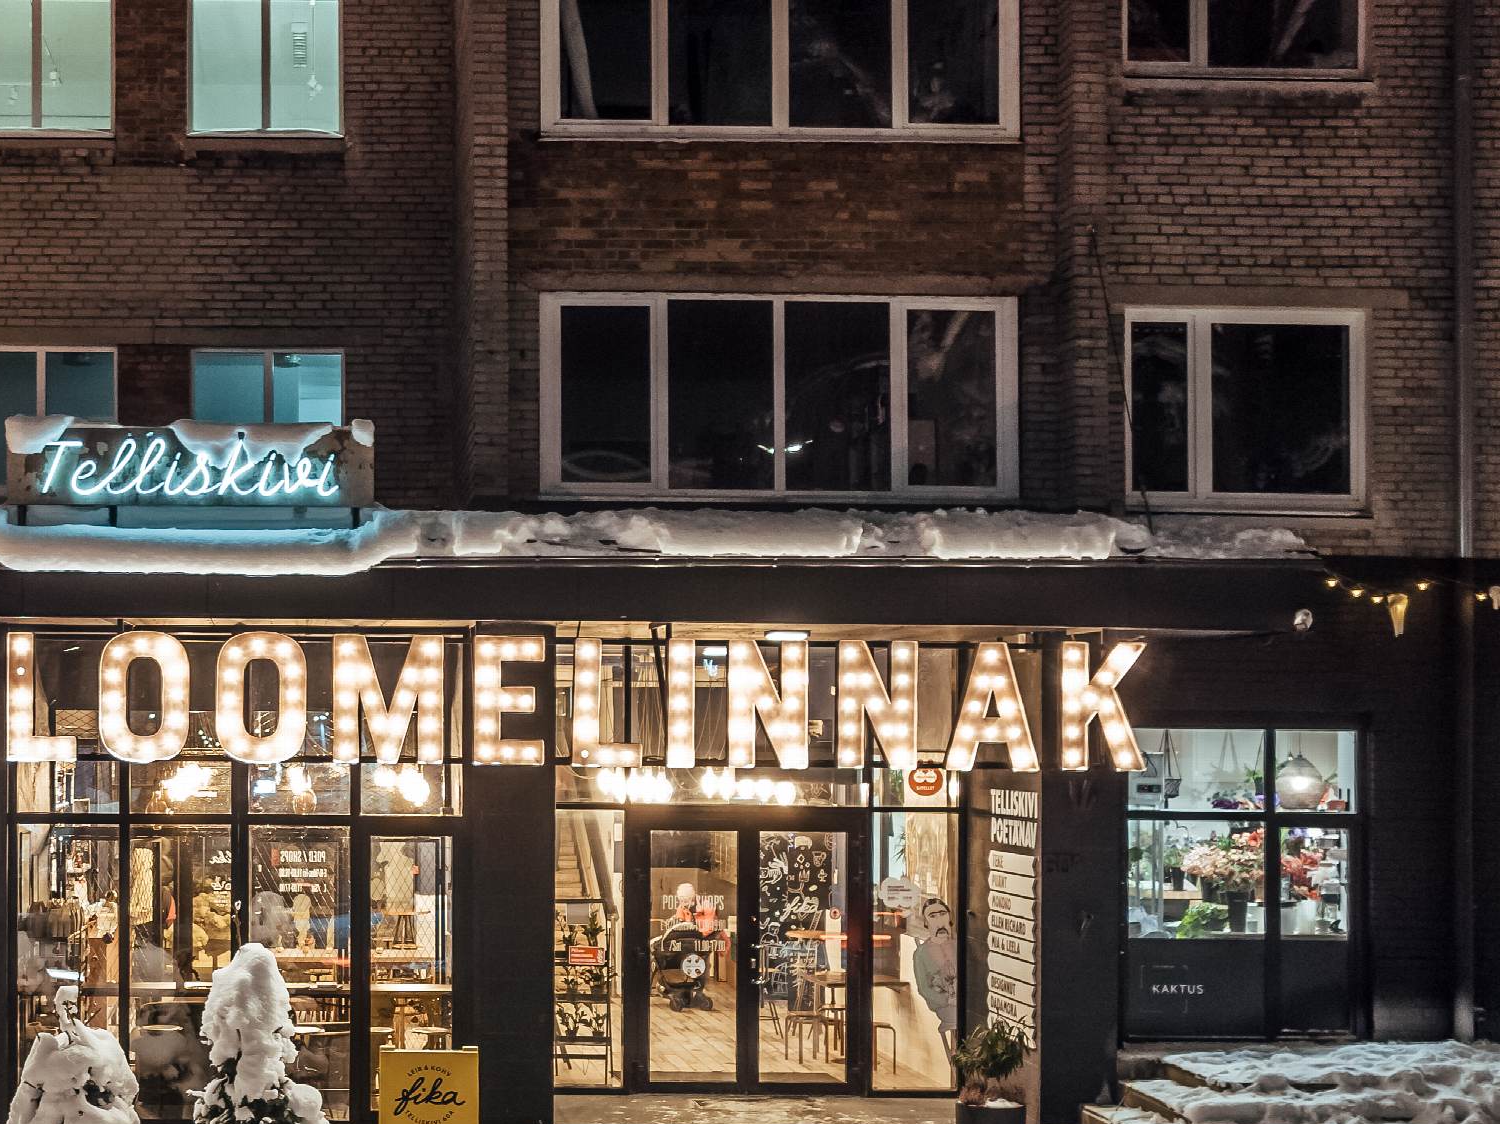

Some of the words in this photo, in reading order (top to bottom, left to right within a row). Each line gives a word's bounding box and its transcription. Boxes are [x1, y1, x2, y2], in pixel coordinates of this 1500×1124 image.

[41, 437, 340, 497] Telliskivi
[6, 631, 1148, 772] LOOMELINNAK
[990, 788, 1038, 819] TELLISKIVI
[695, 894, 725, 911] SHOPS
[1152, 984, 1204, 995] KAKTUS
[393, 1076, 466, 1116] fika
